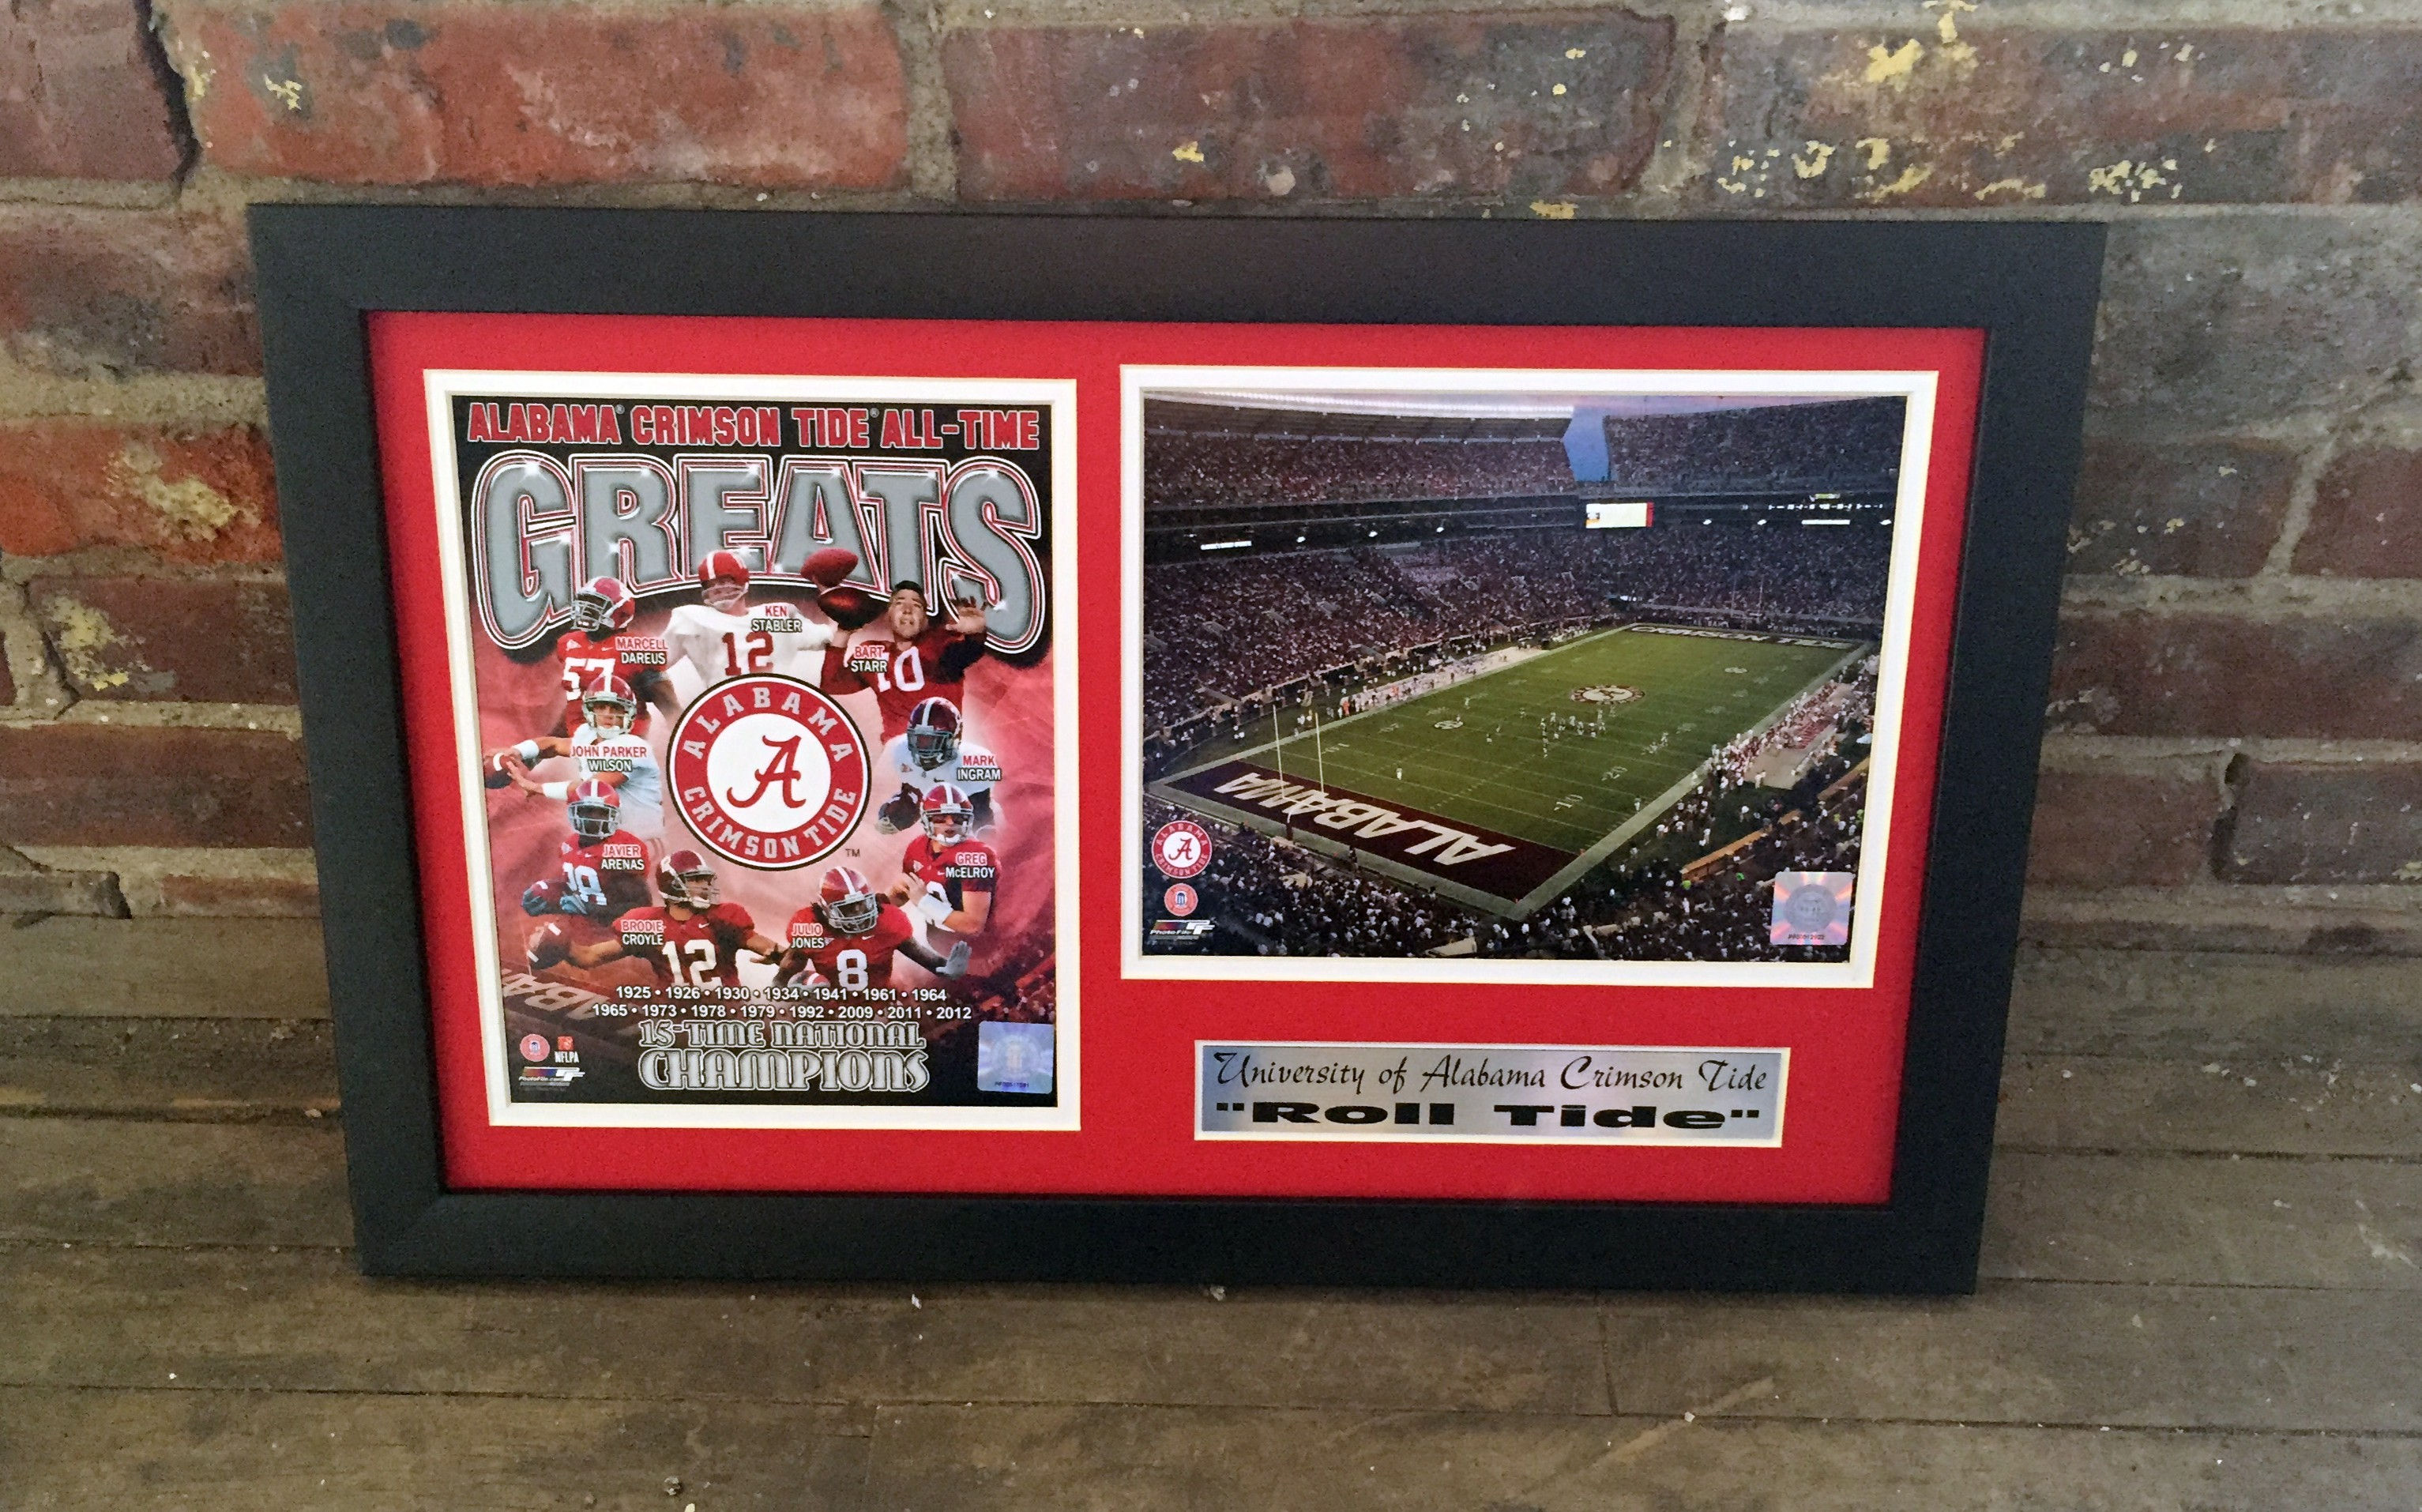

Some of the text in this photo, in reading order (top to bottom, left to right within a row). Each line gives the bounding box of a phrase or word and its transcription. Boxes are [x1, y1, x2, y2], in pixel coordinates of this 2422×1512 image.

[468, 402, 1040, 450] ALABAMA CRIMSON TIDE ALL-TIME
[472, 450, 1042, 653] GREATS
[765, 604, 788, 617] KEN
[751, 619, 803, 632] STABLER
[615, 637, 668, 651] MARCELL
[621, 652, 666, 664] DAREUS
[722, 632, 773, 676] 12
[854, 645, 884, 658] BART
[851, 659, 887, 672] STARR
[683, 686, 853, 762] ALABAMA
[572, 747, 647, 758] JOHN PARKER
[588, 759, 632, 772] WILSON
[963, 755, 995, 766] MARK
[727, 735, 807, 808] A
[957, 769, 1002, 780] INGRAM
[684, 786, 856, 859] CRIMSON TIDE
[1214, 772, 1517, 866] ALABAMA
[603, 844, 641, 857] JAVIER
[1168, 838, 1193, 860] A
[601, 859, 645, 870] ARENAS
[955, 853, 987, 865] GREG
[946, 867, 995, 878] McELROY
[621, 920, 663, 932] BRODIE
[792, 923, 823, 935] JULIO
[622, 934, 663, 946] CROYLE
[791, 937, 825, 949] JONES
[663, 939, 722, 987] 12
[837, 950, 868, 991] 8
[616, 987, 947, 1001] 1925 1926 1930 1934 1941 1961 1964
[592, 1004, 972, 1019] 1965 1973 1978 1979 1992 2009 2011 2012
[638, 1020, 927, 1049] 15-TIME NATIONAL
[555, 1051, 579, 1063] NFLPA
[638, 1048, 930, 1093] CHAMPIONS
[1214, 1051, 1768, 1096] University of Alabama Crimson Tide
